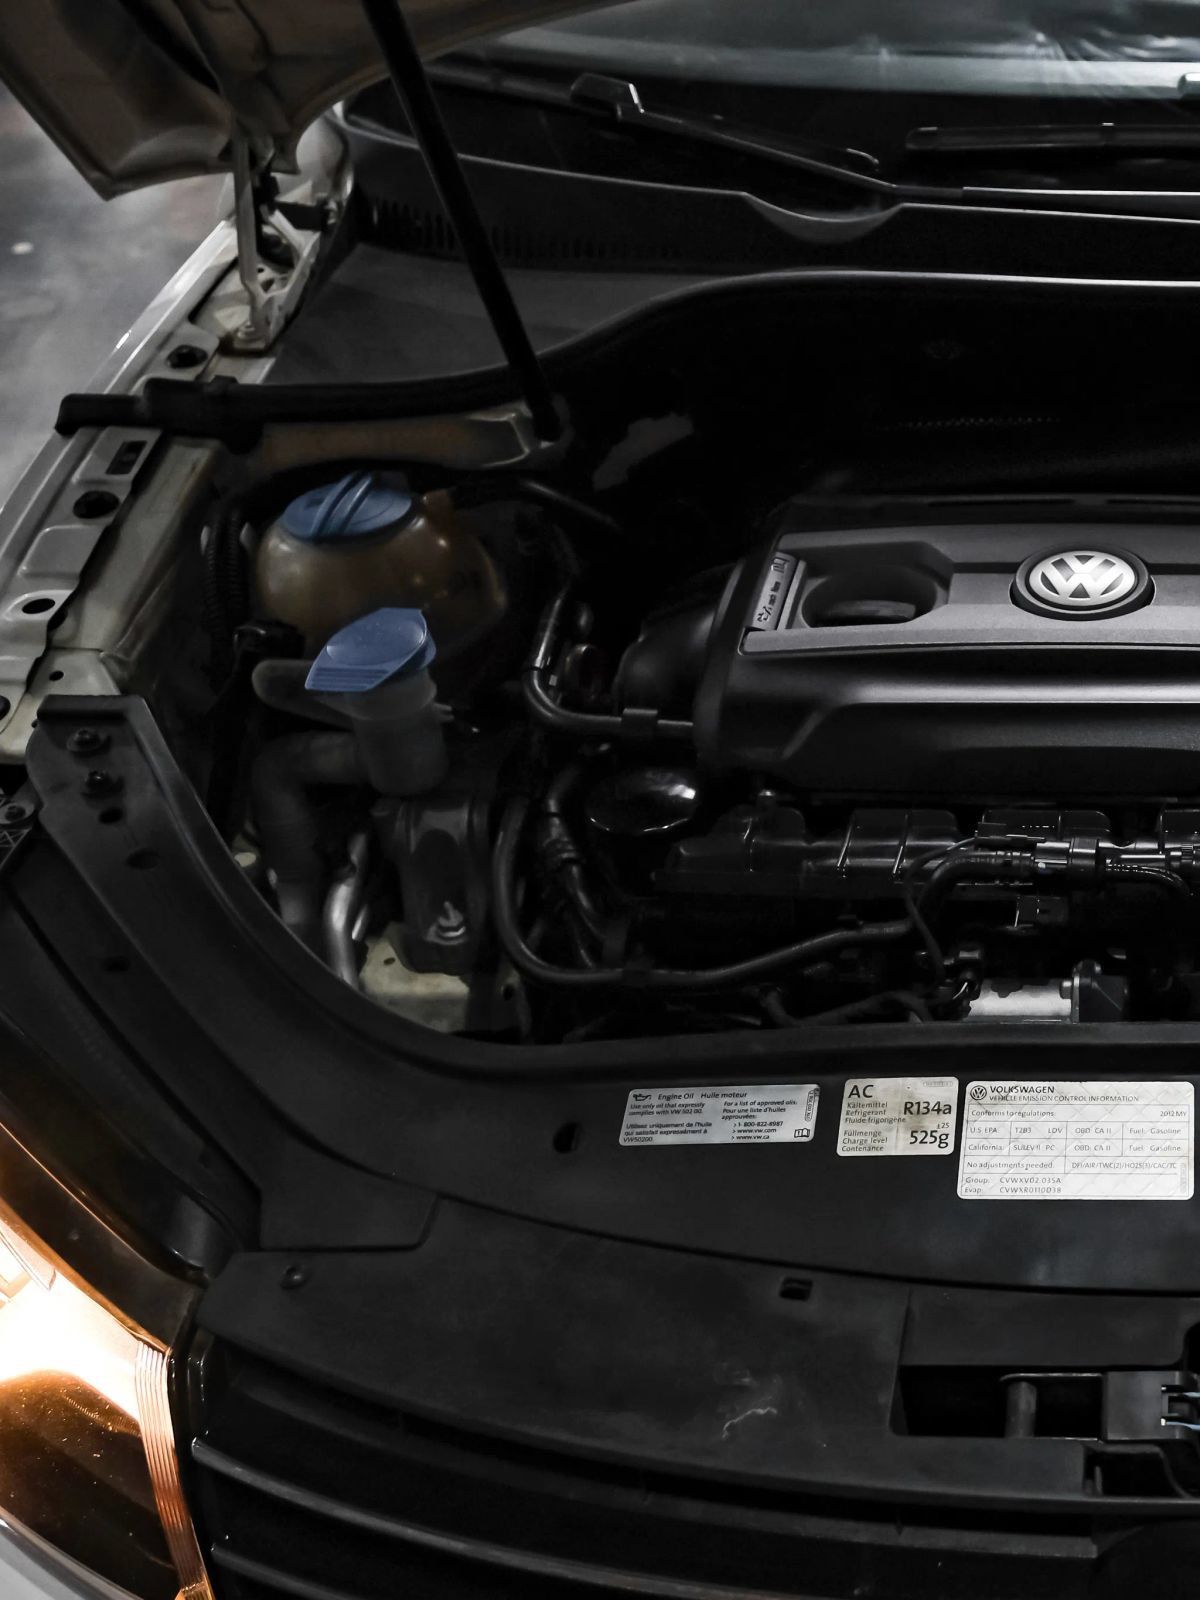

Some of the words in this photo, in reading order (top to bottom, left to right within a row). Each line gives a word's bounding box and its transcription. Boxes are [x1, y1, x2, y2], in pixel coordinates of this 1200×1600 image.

[848, 1084, 874, 1098] AC
[990, 1085, 1055, 1094] VOLKSWAGEN
[658, 1093, 682, 1101] Engine
[904, 1101, 952, 1115] R134a
[846, 1109, 886, 1117] Refrigerant
[844, 1130, 882, 1138] Füllmenge
[910, 1130, 950, 1149] 525g
[979, 1162, 1025, 1170] adjustments
